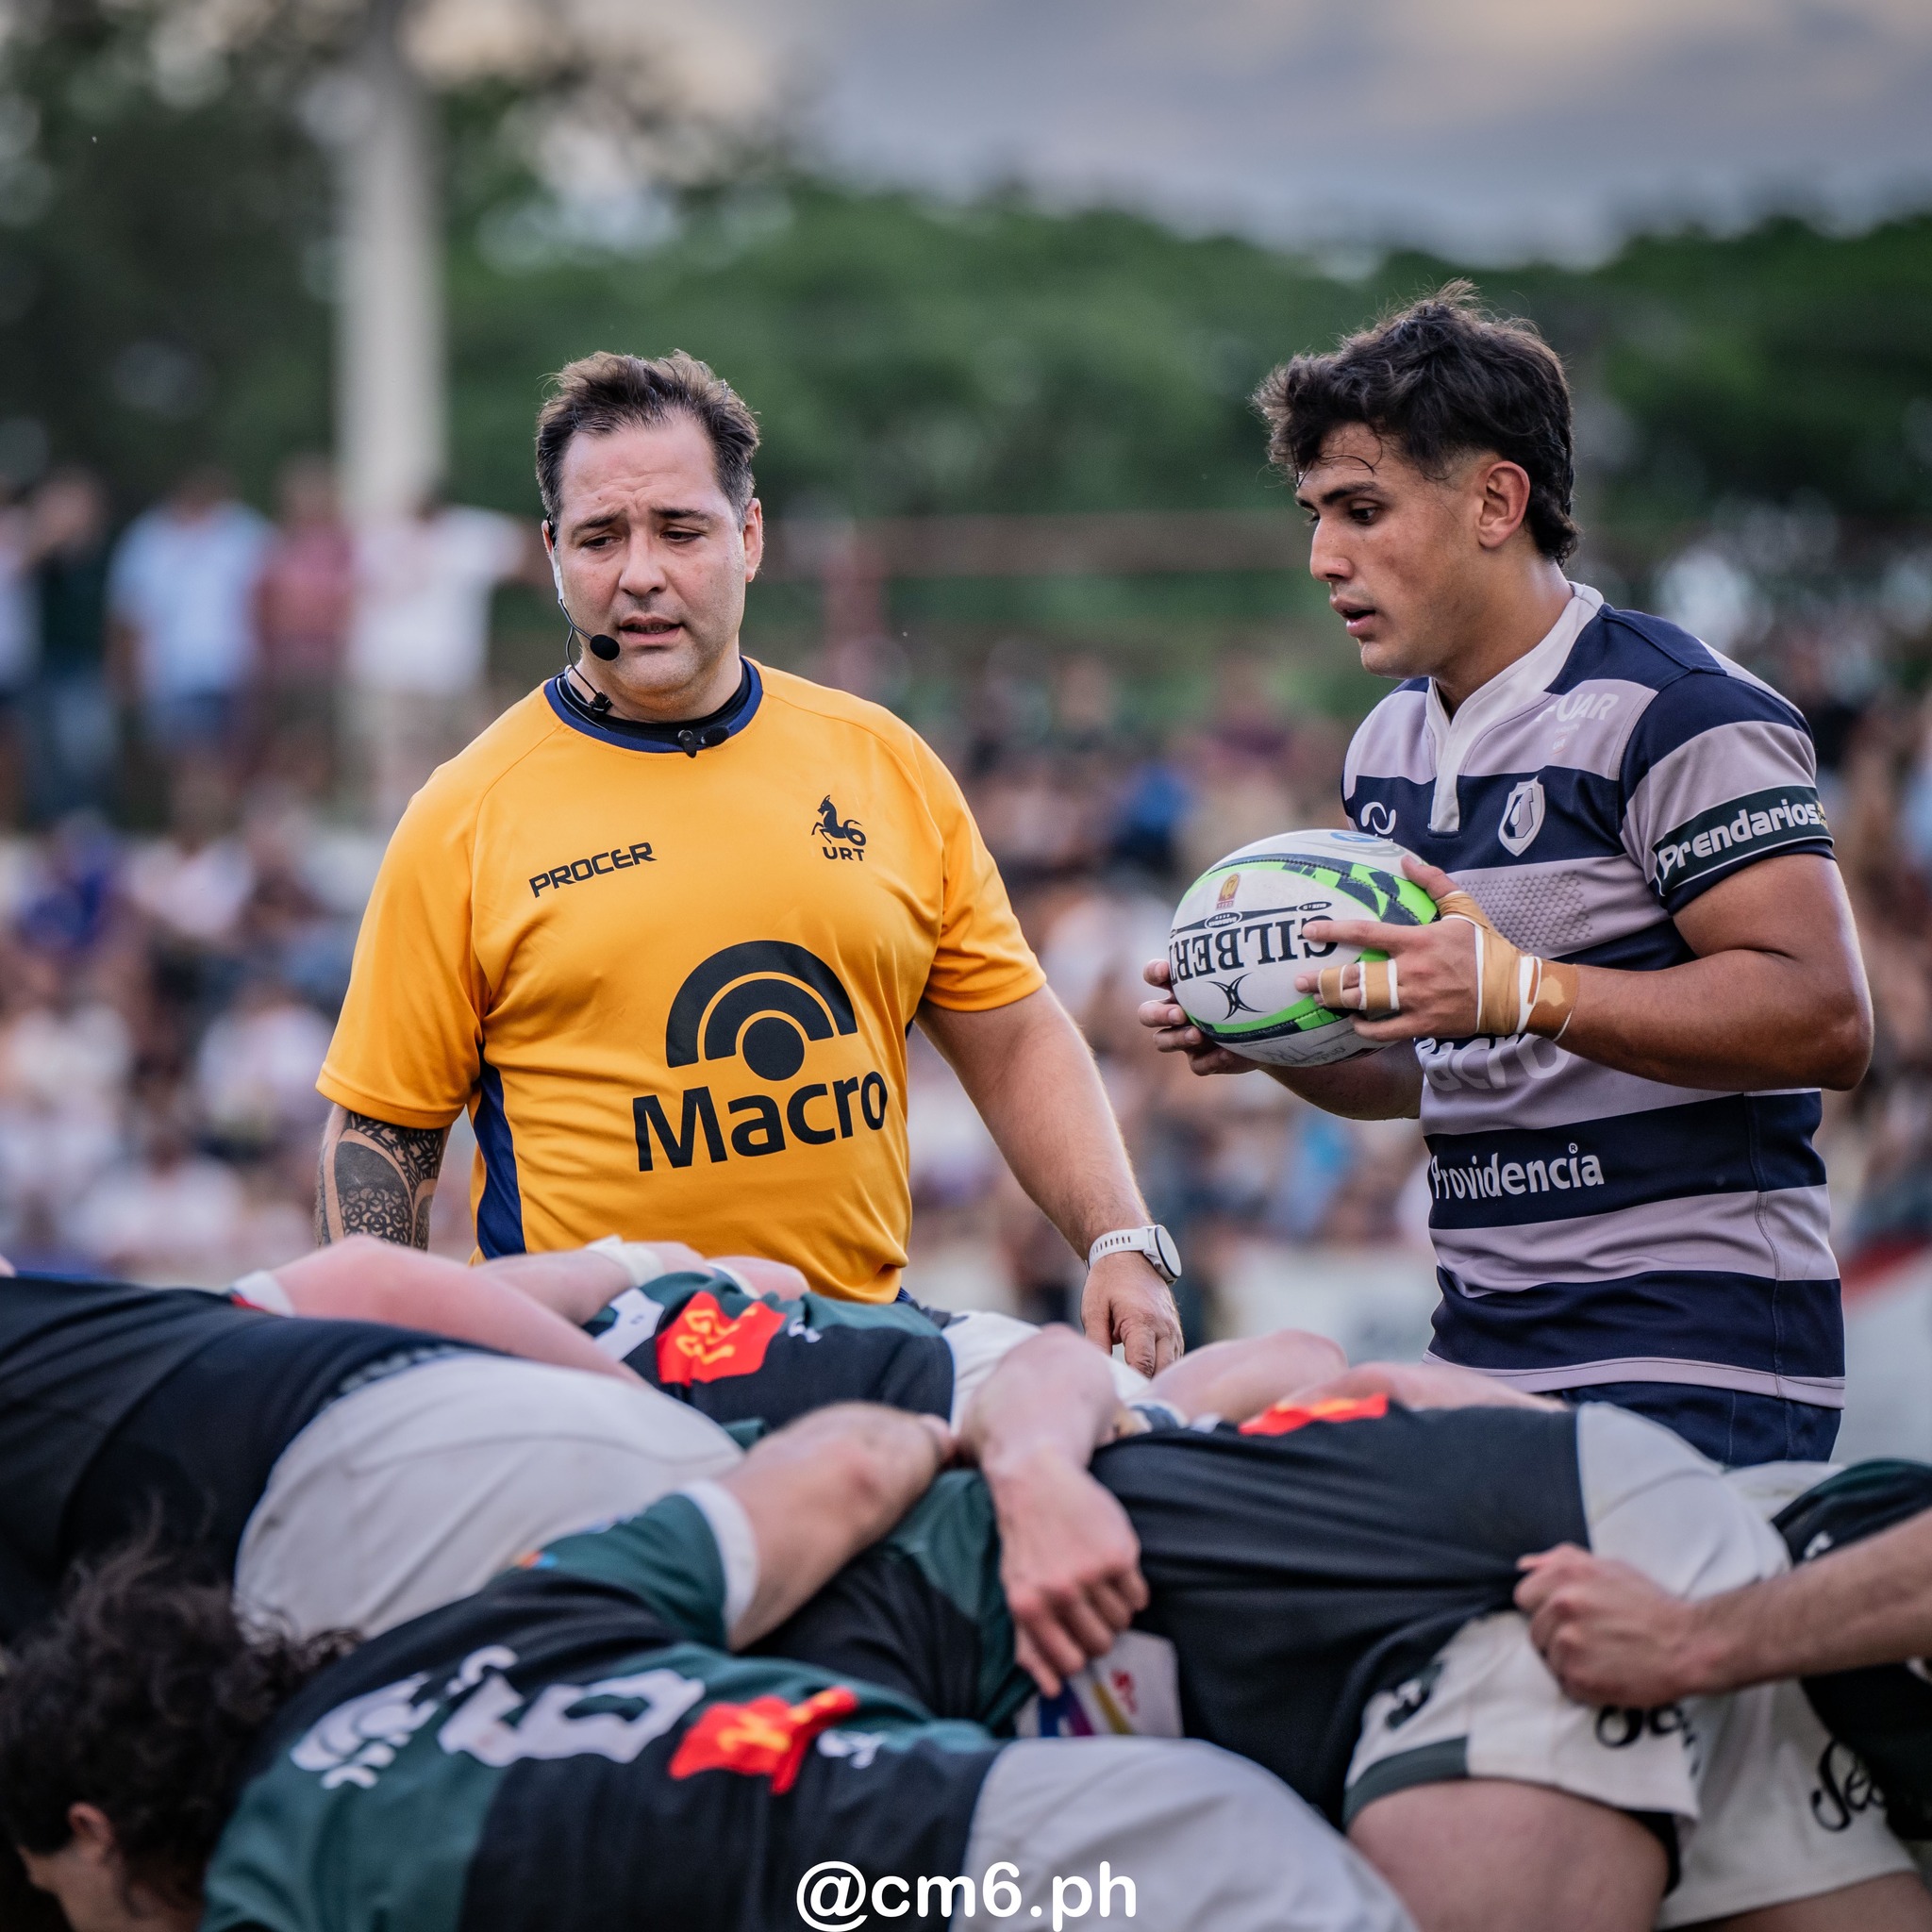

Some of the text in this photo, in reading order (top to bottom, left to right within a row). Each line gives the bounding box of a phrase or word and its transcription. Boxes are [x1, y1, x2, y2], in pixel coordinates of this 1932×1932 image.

[528, 841, 658, 899] PROCER
[823, 846, 865, 862] URT
[1658, 799, 1820, 880] Prendarios
[632, 1071, 888, 1173] Macro
